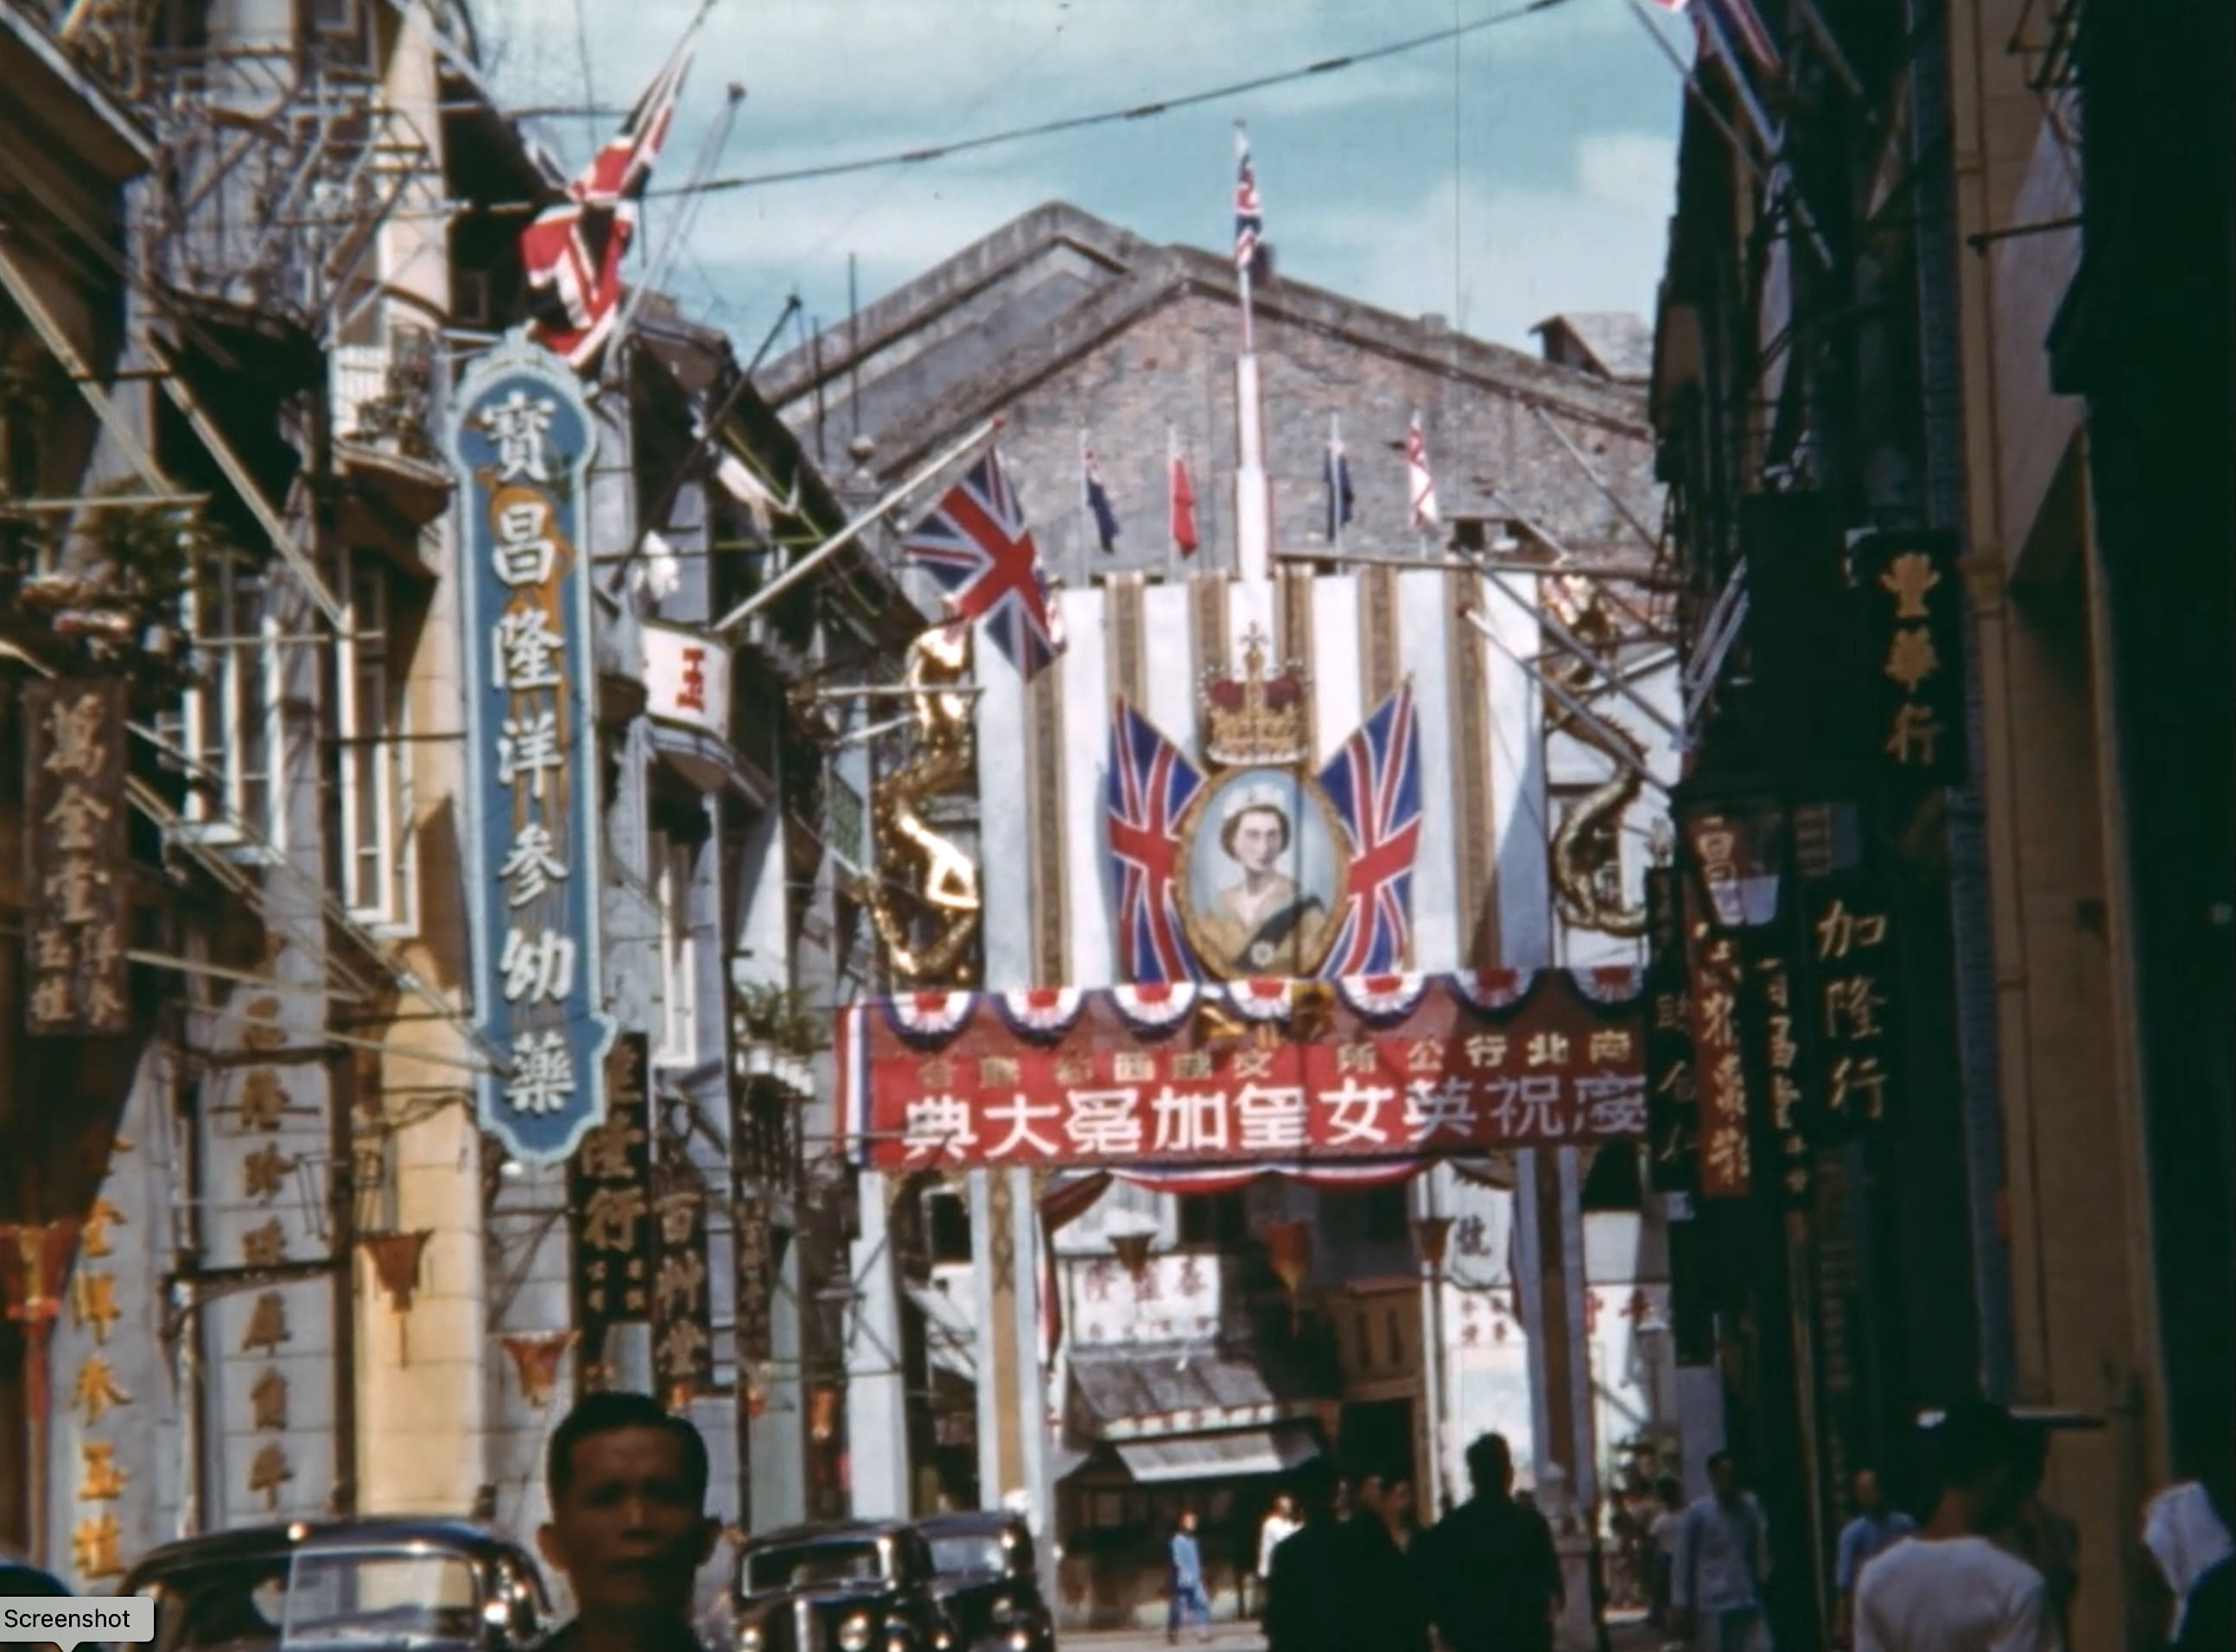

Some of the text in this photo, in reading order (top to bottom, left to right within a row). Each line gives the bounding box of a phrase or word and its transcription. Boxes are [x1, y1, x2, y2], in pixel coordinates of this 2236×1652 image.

[1819, 899, 1890, 1116] 加隆行
[904, 1070, 1647, 1160] 慶祝英女皇加冕大典
